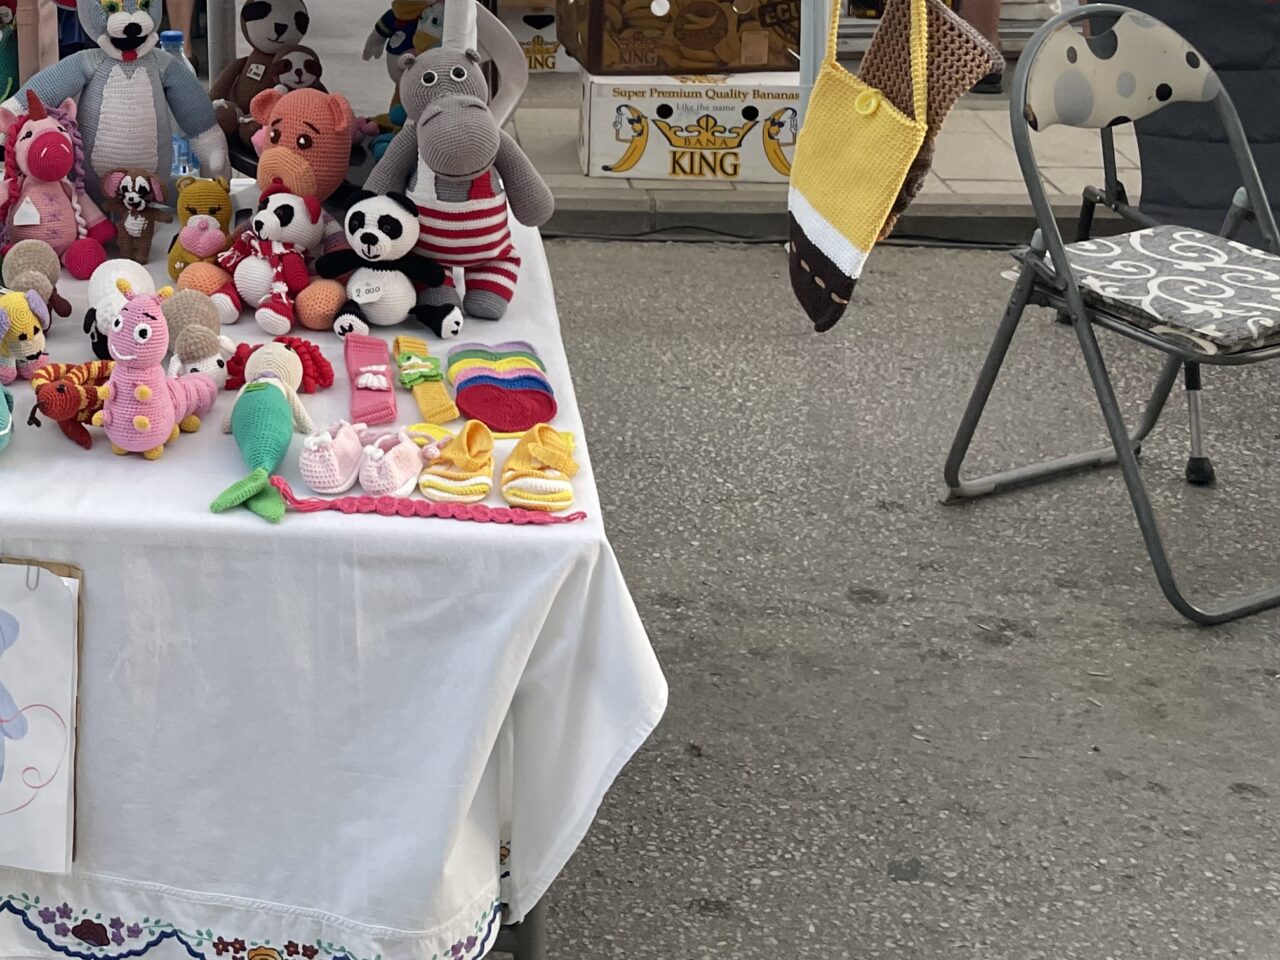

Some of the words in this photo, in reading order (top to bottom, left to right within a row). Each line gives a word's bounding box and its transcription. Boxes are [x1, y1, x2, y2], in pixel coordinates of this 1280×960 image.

[525, 55, 557, 71] ING
[612, 87, 647, 100] Super
[650, 87, 703, 99] Premium
[705, 88, 749, 102] Quality
[752, 89, 800, 101] Bananas
[676, 102, 695, 113] Like
[696, 103, 711, 113] the
[712, 104, 736, 113] name
[683, 136, 729, 148] BANA
[668, 150, 740, 178] KING
